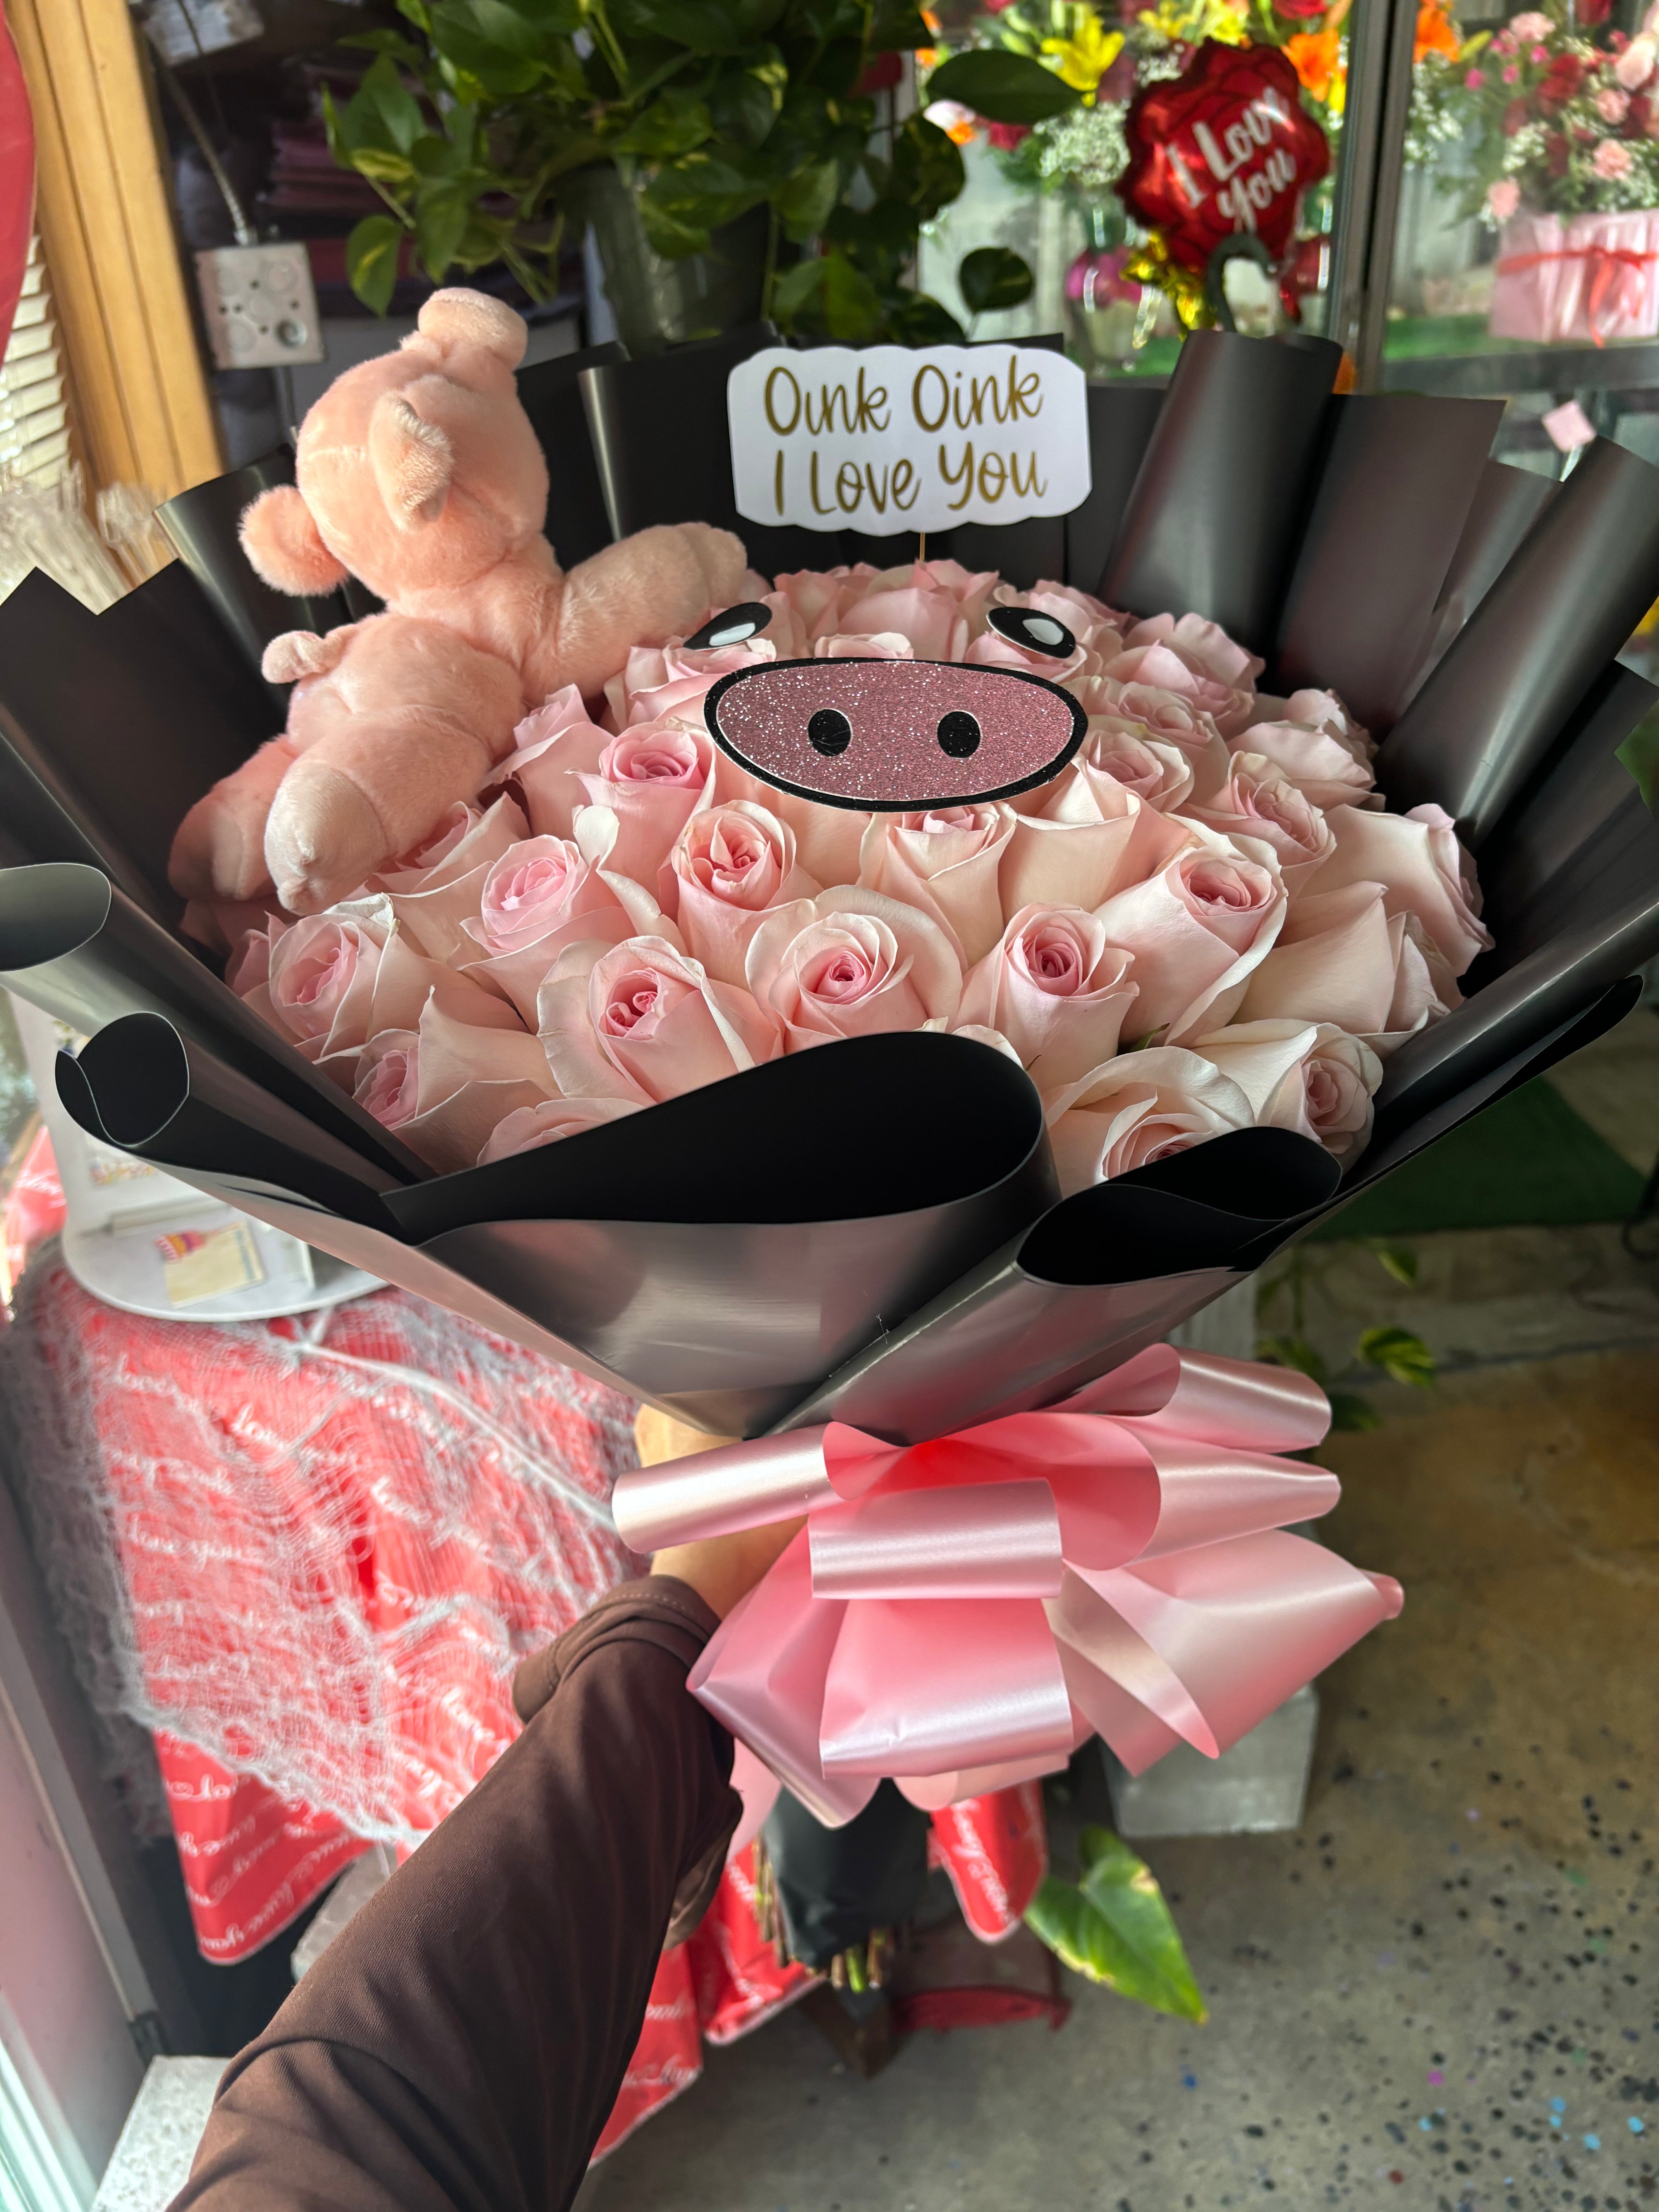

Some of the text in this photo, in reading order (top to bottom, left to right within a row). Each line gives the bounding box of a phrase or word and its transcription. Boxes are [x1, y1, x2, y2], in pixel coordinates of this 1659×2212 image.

[1166, 143, 1207, 208] I
[764, 354, 1044, 436] Oink Oink
[775, 441, 1049, 516] I Love You
